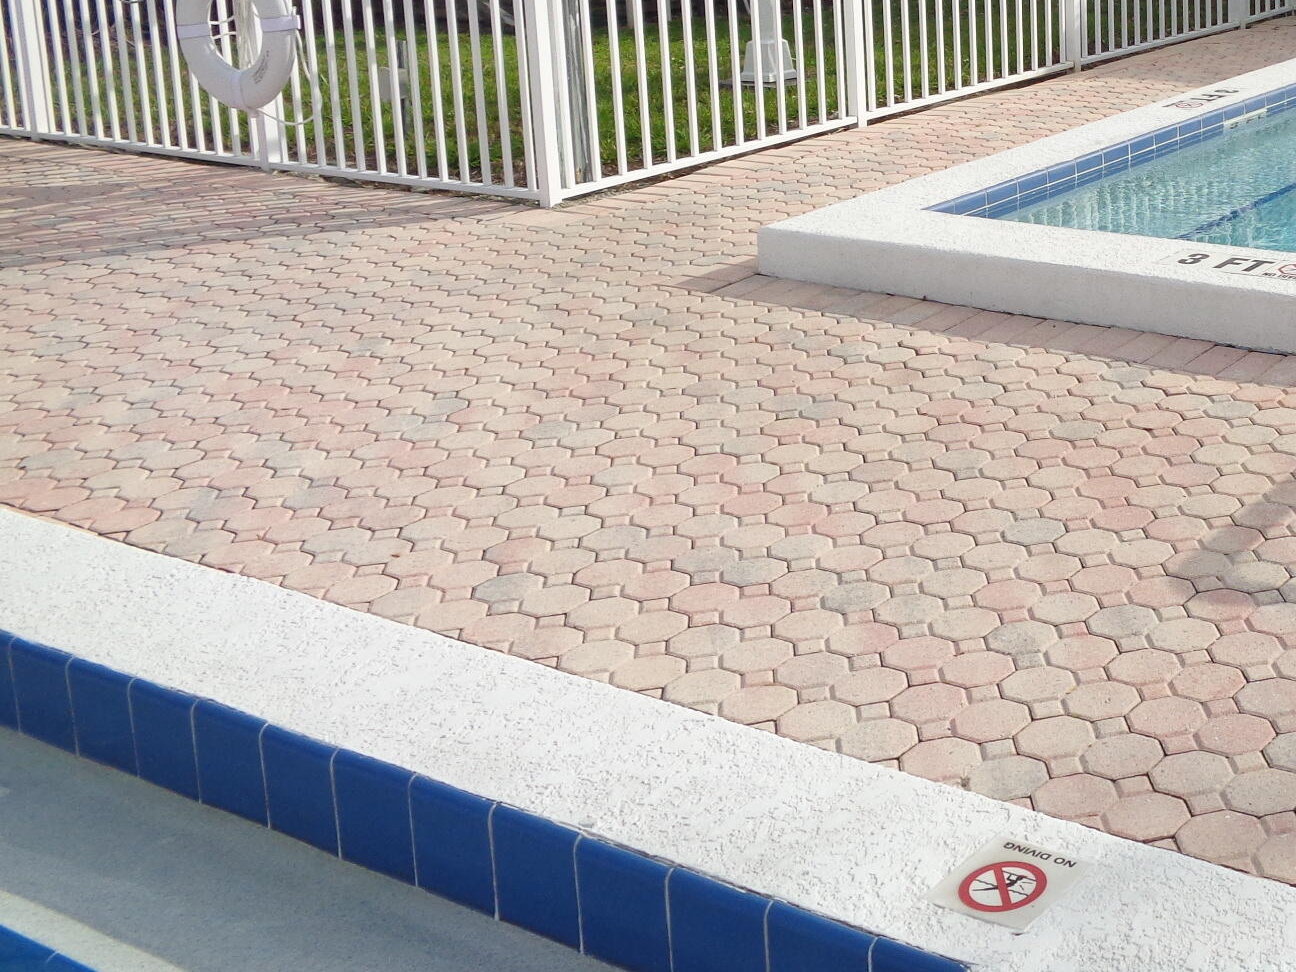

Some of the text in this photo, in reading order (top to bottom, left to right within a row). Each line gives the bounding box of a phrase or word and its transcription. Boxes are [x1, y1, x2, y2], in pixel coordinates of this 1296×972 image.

[1177, 253, 1275, 272] 3 FT
[1003, 841, 1077, 868] NO DIVING
